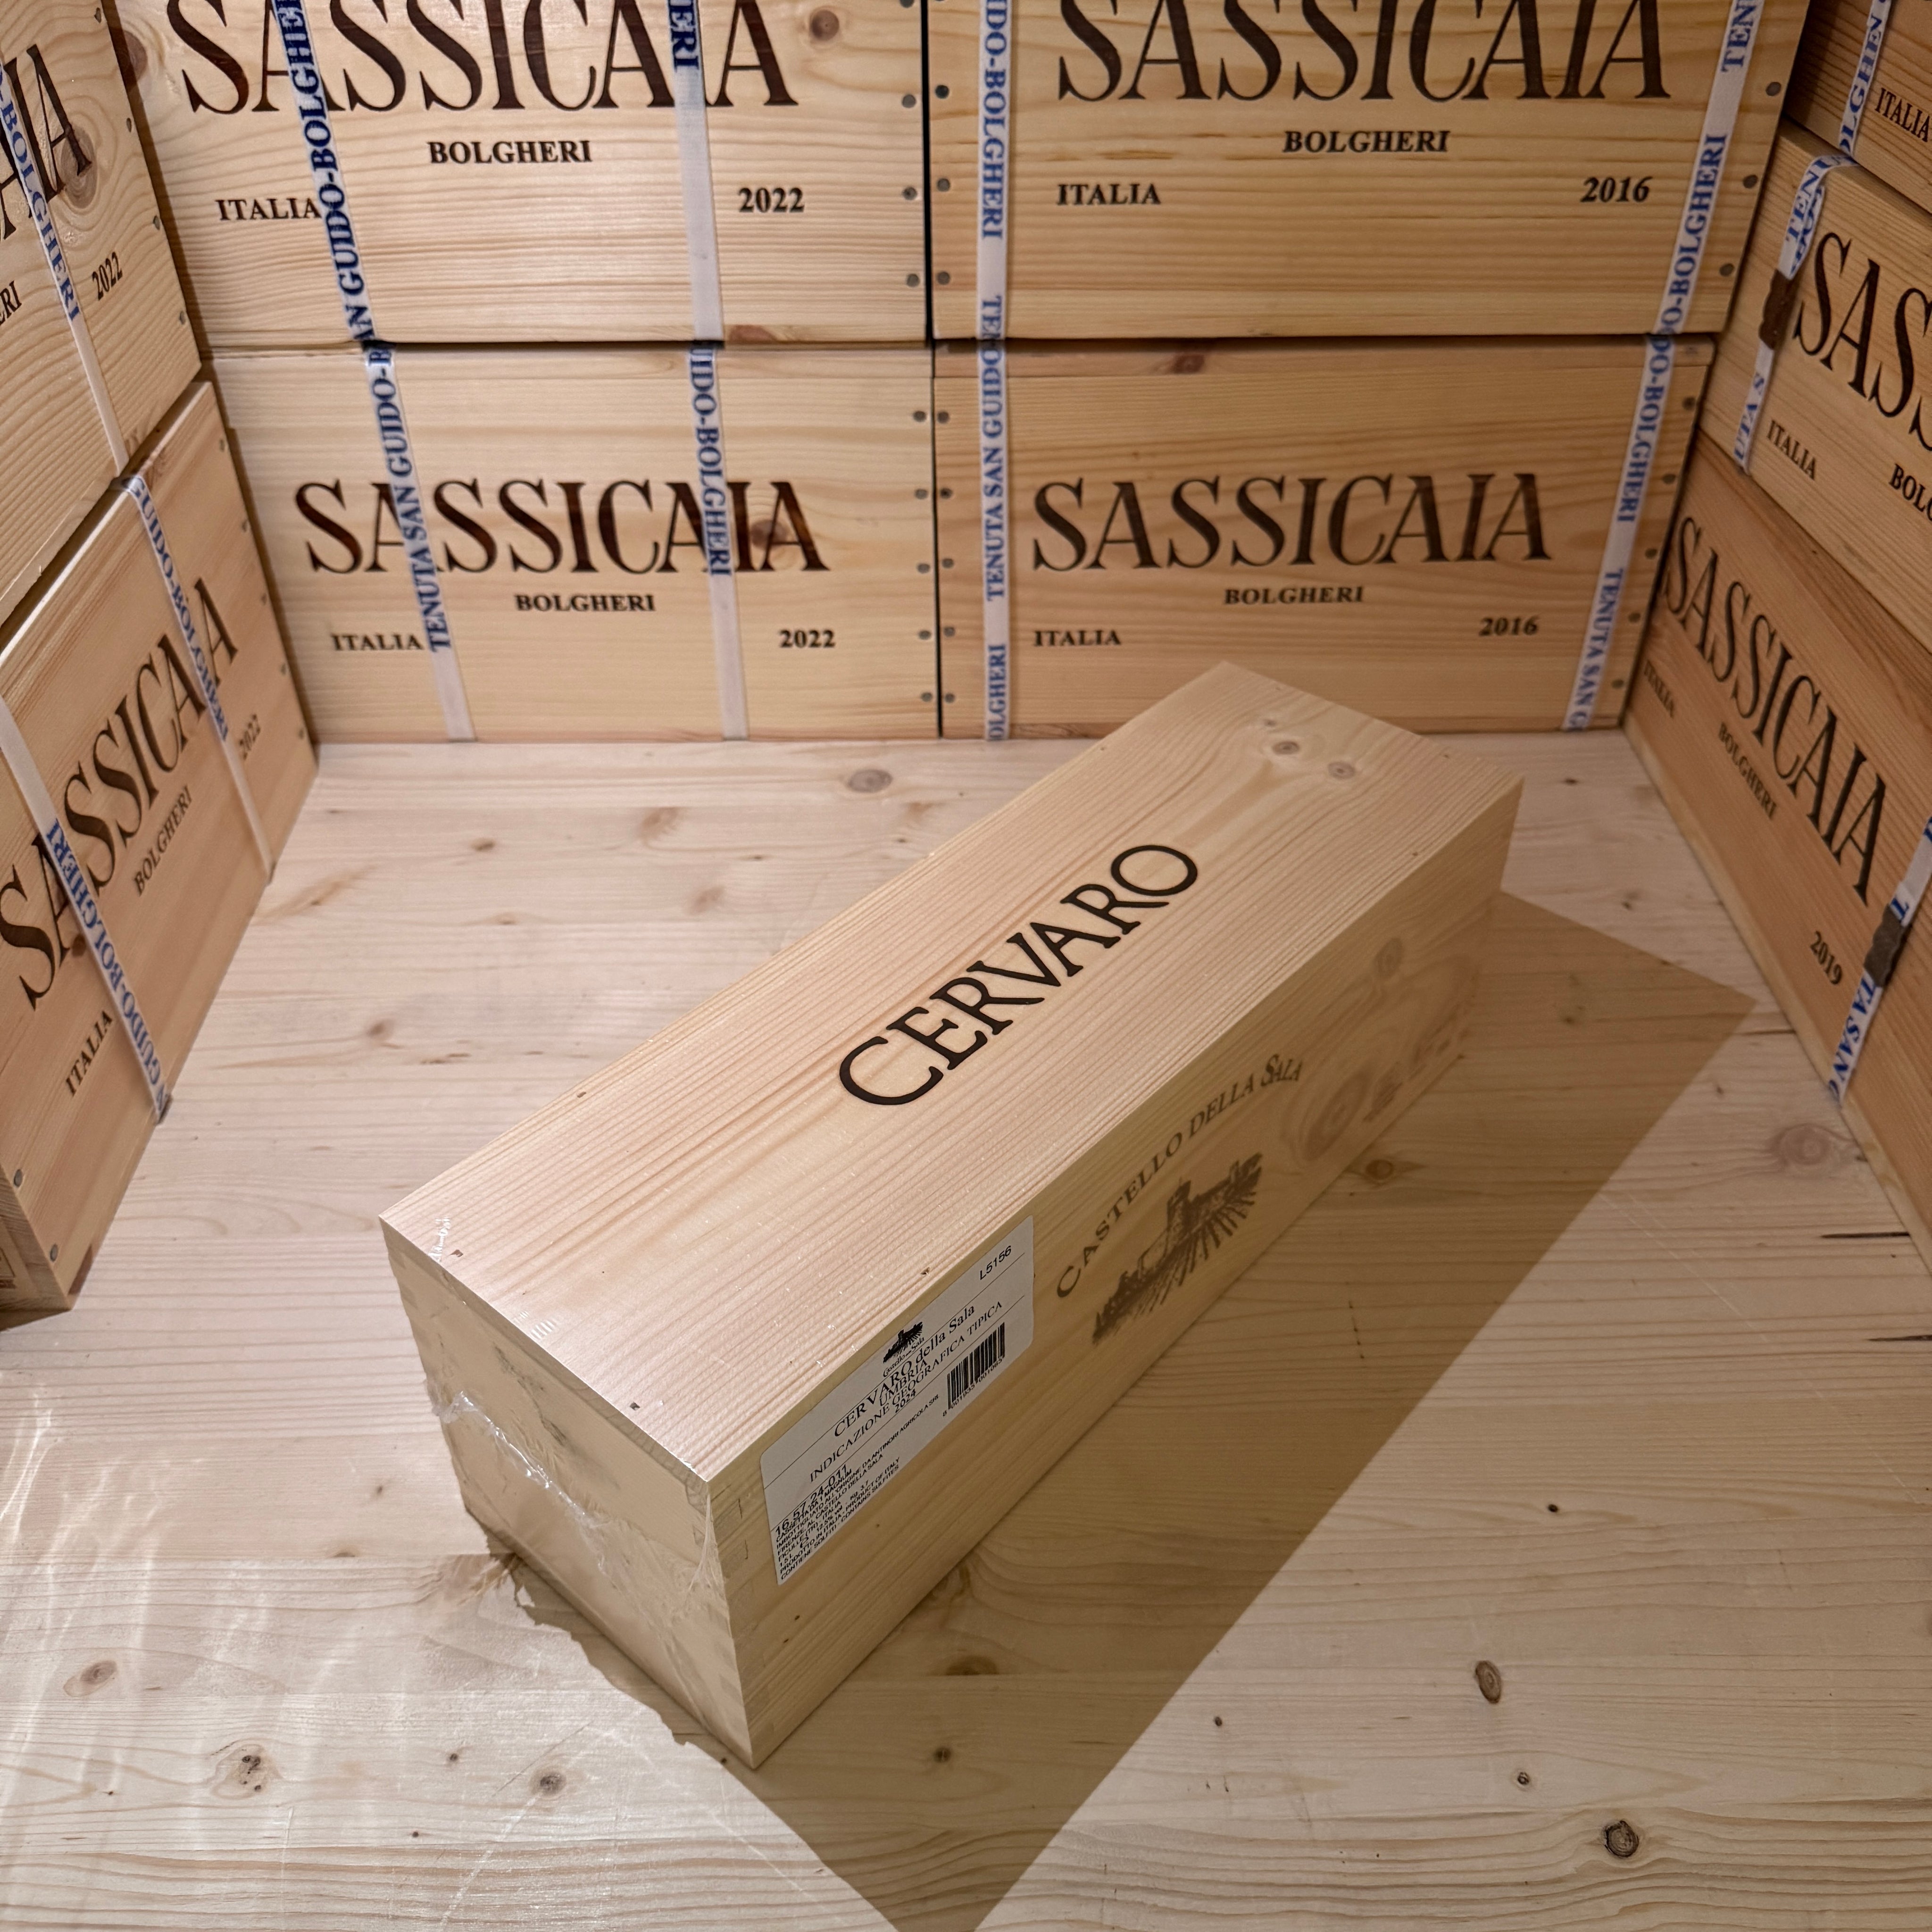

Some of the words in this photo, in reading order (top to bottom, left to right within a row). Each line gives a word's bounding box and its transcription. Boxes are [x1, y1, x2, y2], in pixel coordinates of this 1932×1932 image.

[1058, 0, 1671, 101] SASSICAIA
[1282, 130, 1450, 153] BOLGHERI
[1875, 87, 1930, 142] ITALIA
[429, 140, 592, 164] BOLGHERI
[215, 198, 321, 221] ITALIA
[739, 188, 805, 213] 2022
[1058, 183, 1161, 206] ITALIA
[1580, 176, 1653, 202] 2016
[92, 252, 123, 301] 2022
[983, 447, 1003, 498] SAN
[1766, 420, 1816, 481] ITALIA
[393, 488, 426, 543] SAN
[1033, 473, 1552, 572] SASSICAIA
[984, 504, 1005, 601] TENUTA
[409, 550, 451, 652] TENUTA
[516, 594, 656, 612] BOLGHERI
[1224, 586, 1365, 605] BOLGHERI
[1587, 568, 1623, 659] TENUTA
[332, 633, 423, 651] ITALIA
[780, 629, 836, 649] 2022
[1034, 629, 1122, 647] ITALIA
[1479, 616, 1539, 637] 2016
[1576, 664, 1600, 707] SAN
[1663, 517, 1886, 907] SASSICAIA
[239, 714, 261, 760] 2022
[0, 578, 238, 1011] SASSICAA
[1719, 722, 1778, 821] BOLGHERI
[133, 785, 192, 897] BOLGHERI
[839, 844, 1199, 1106] CERVARO
[1809, 930, 1843, 985] 2019
[65, 1010, 114, 1097] ITALIA
[1057, 1133, 1183, 1298] CASTELLO
[1189, 1073, 1254, 1139] DELLA
[980, 1245, 1012, 1280] L5156
[810, 1402, 890, 1482] INDICAZIONE
[892, 1335, 965, 1406] GEOGRAFICA
[966, 1301, 1002, 1336] TIPICA
[833, 1360, 912, 1437] CERVARO
[916, 1332, 946, 1365] della
[949, 1306, 975, 1334] Sala
[879, 1359, 927, 1407] UMBRIA
[894, 1388, 917, 1415] 2024
[776, 1502, 824, 1549] IMBOTTIGLIATO
[871, 1431, 899, 1461] ANTINORI
[899, 1404, 929, 1434] AGRICOLA
[815, 1487, 847, 1520] CASTELLO
[848, 1468, 867, 1490] DELLA
[867, 1453, 883, 1470] SALA
[824, 1468, 852, 1498] MAGNUM
[778, 1533, 805, 1562] FICULLE
[822, 1500, 841, 1521] ITALIA
[780, 1538, 815, 1574] PRODOTTO
[816, 1531, 823, 1541] IN
[823, 1513, 842, 1533] ITALIA
[845, 1481, 874, 1512] PRODUCT
[875, 1472, 883, 1483] OF
[884, 1456, 900, 1474] ITALY
[781, 1547, 812, 1580] CONTIENE
[841, 1491, 871, 1523] CONTAINS
[872, 1464, 899, 1493] SULFITES
